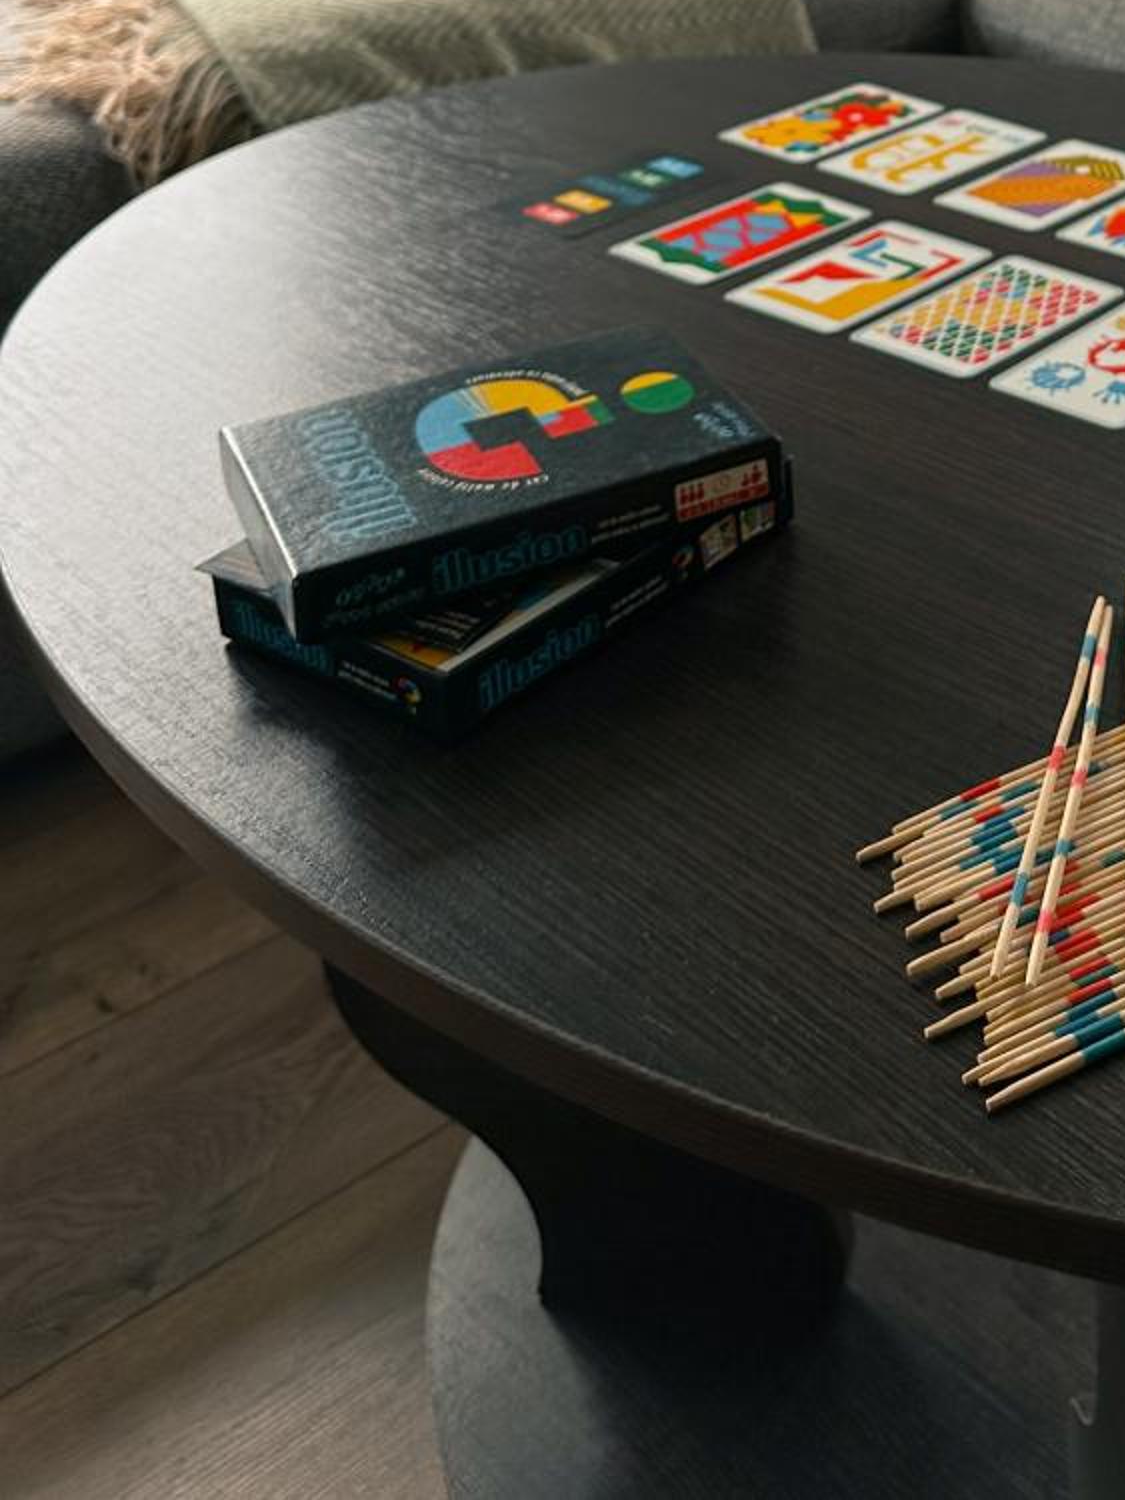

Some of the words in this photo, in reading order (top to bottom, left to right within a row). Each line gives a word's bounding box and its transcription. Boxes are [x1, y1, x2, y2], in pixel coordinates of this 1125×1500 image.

[302, 408, 418, 542] illusion
[432, 524, 589, 595] illusion
[480, 614, 604, 708] illusion
